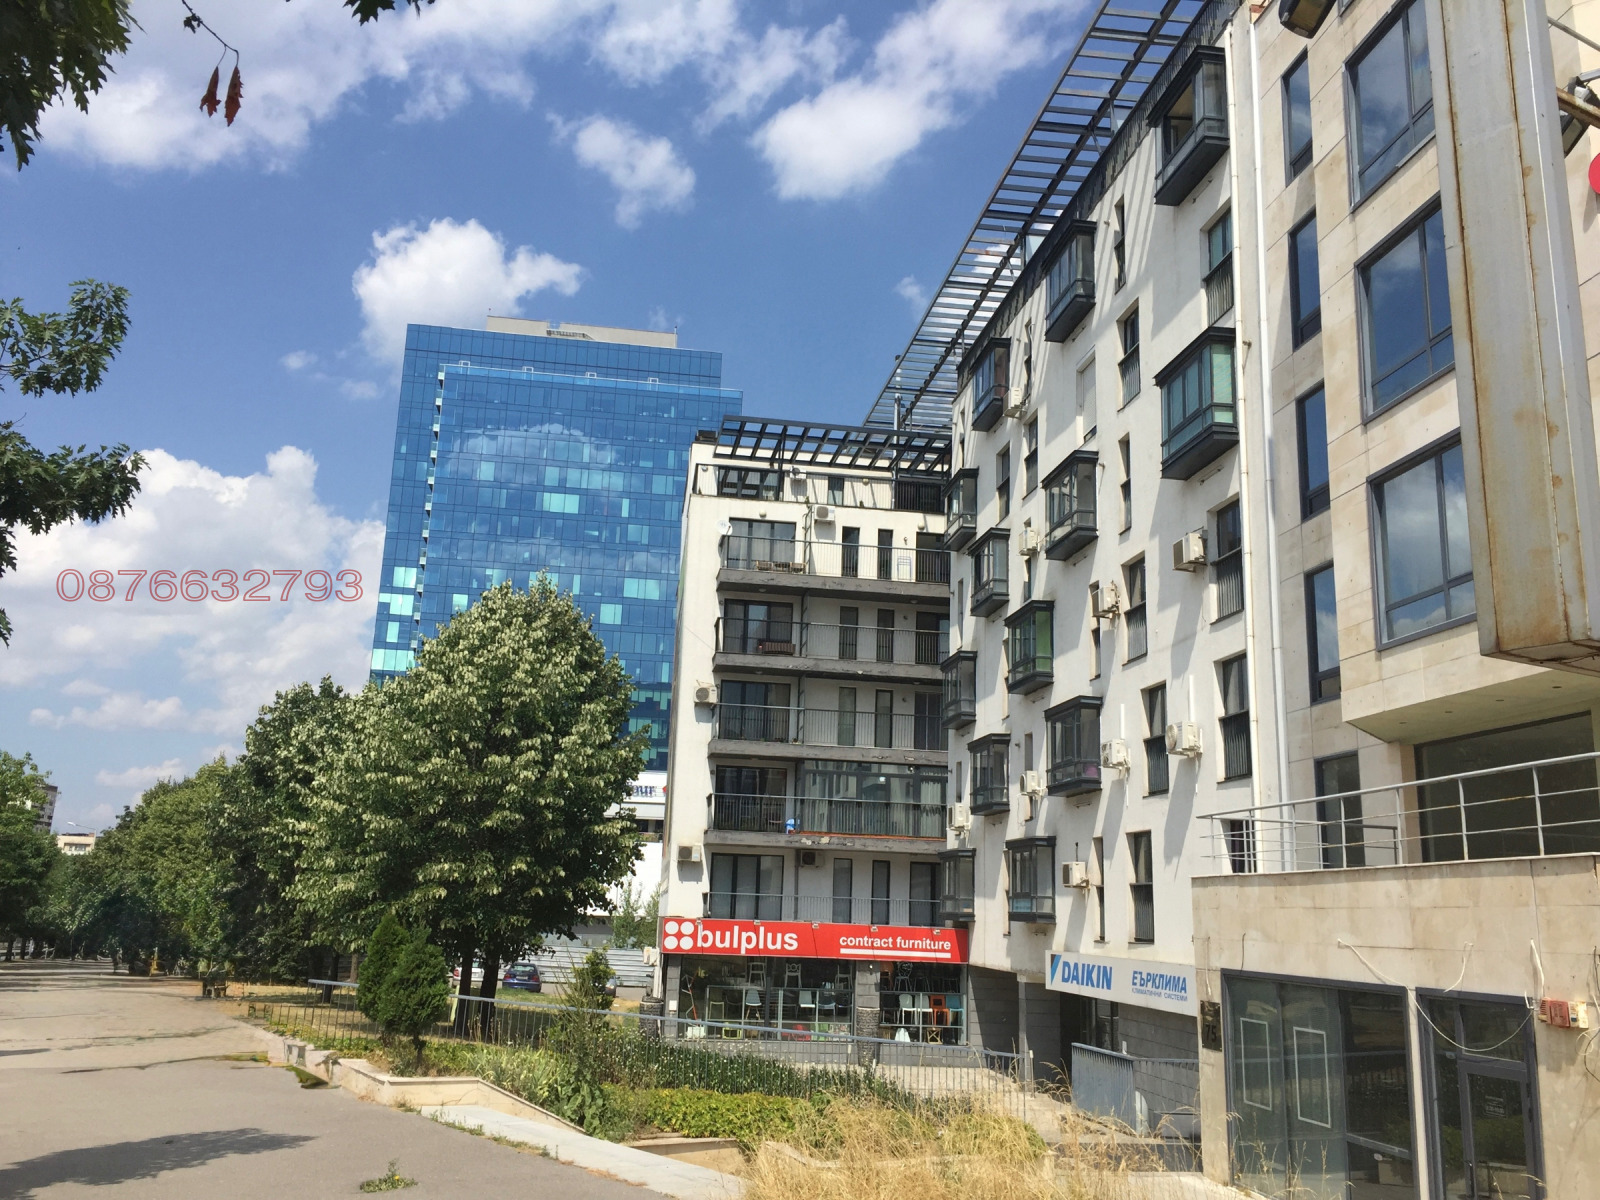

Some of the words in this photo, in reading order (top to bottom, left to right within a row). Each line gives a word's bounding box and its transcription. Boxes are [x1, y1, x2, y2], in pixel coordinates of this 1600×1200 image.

[697, 923, 799, 954] bulplus
[839, 935, 893, 948] contract
[896, 936, 951, 950] furniture
[1061, 960, 1112, 990] DAIKIN
[1131, 970, 1187, 994] ЕЪРКЛИМА
